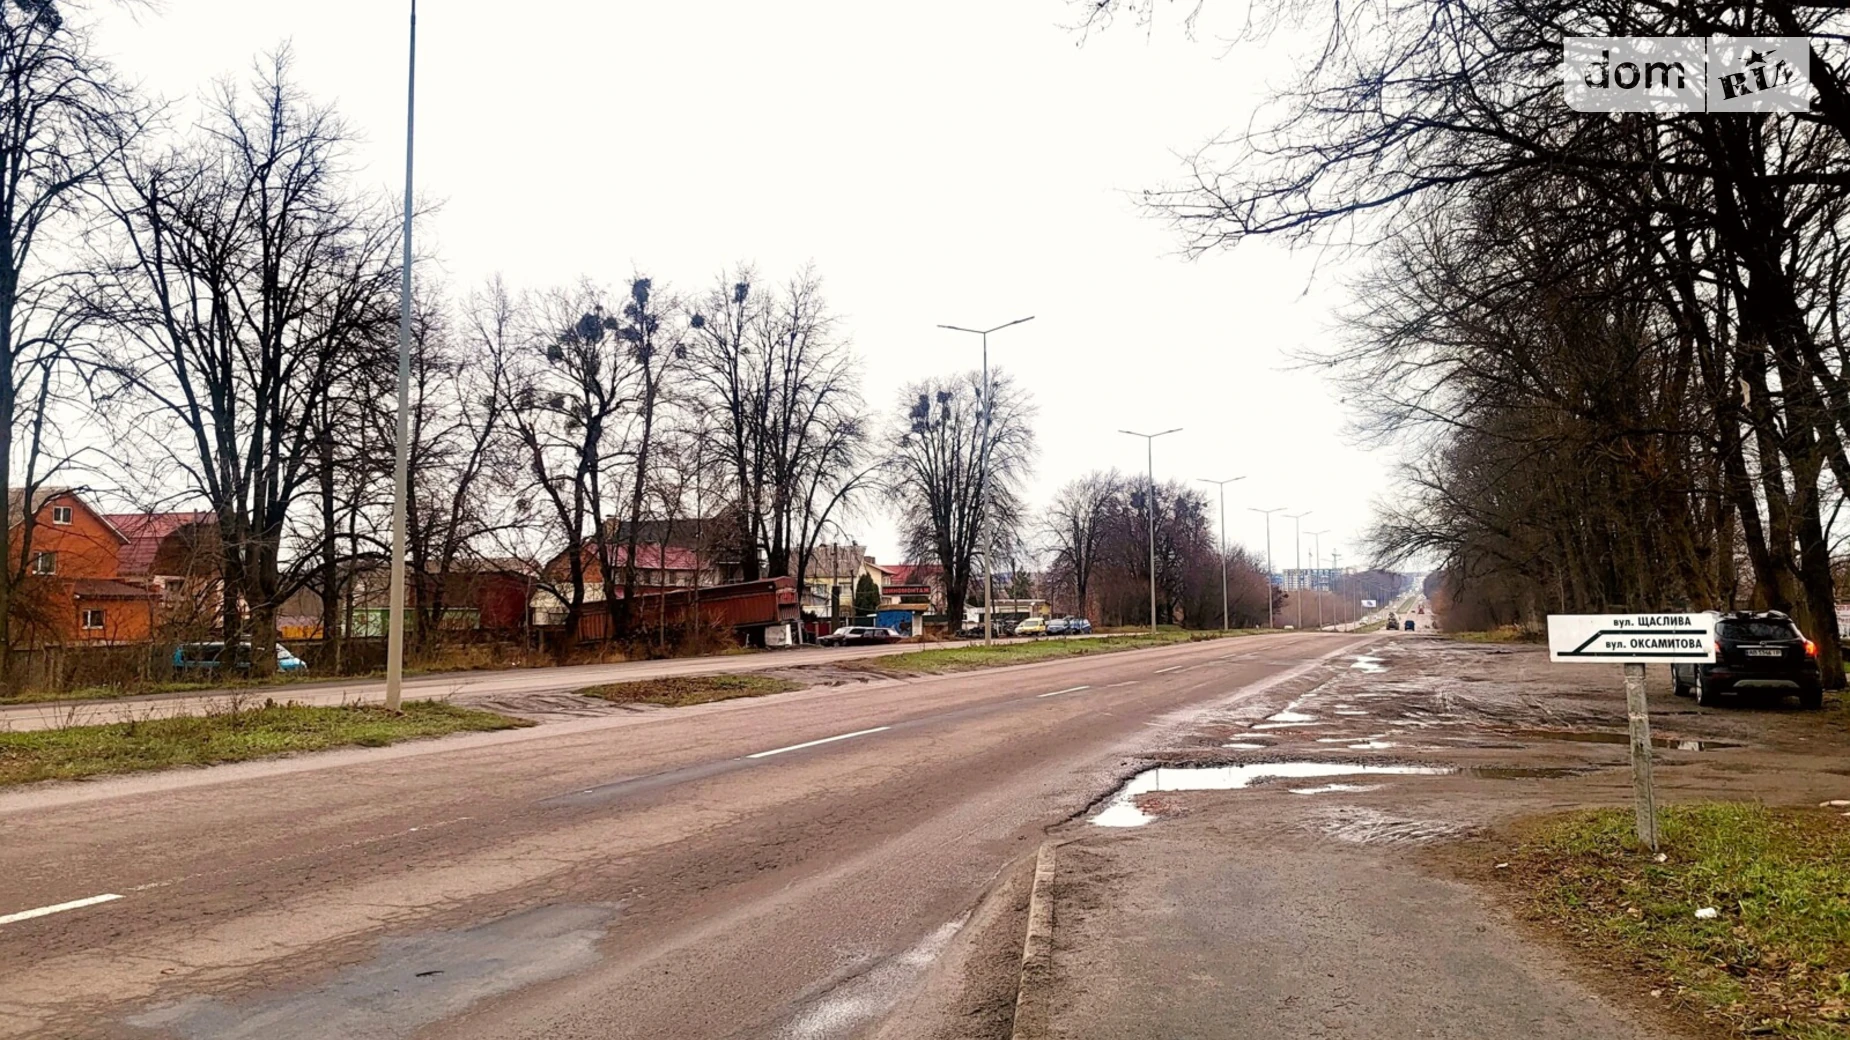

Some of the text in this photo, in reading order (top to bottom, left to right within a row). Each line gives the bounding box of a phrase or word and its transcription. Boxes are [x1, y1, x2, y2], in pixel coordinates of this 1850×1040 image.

[1613, 616, 1692, 628] вул. ЩАСЛИВА
[1605, 639, 1703, 651] вул. ОКСАМИТОВА
